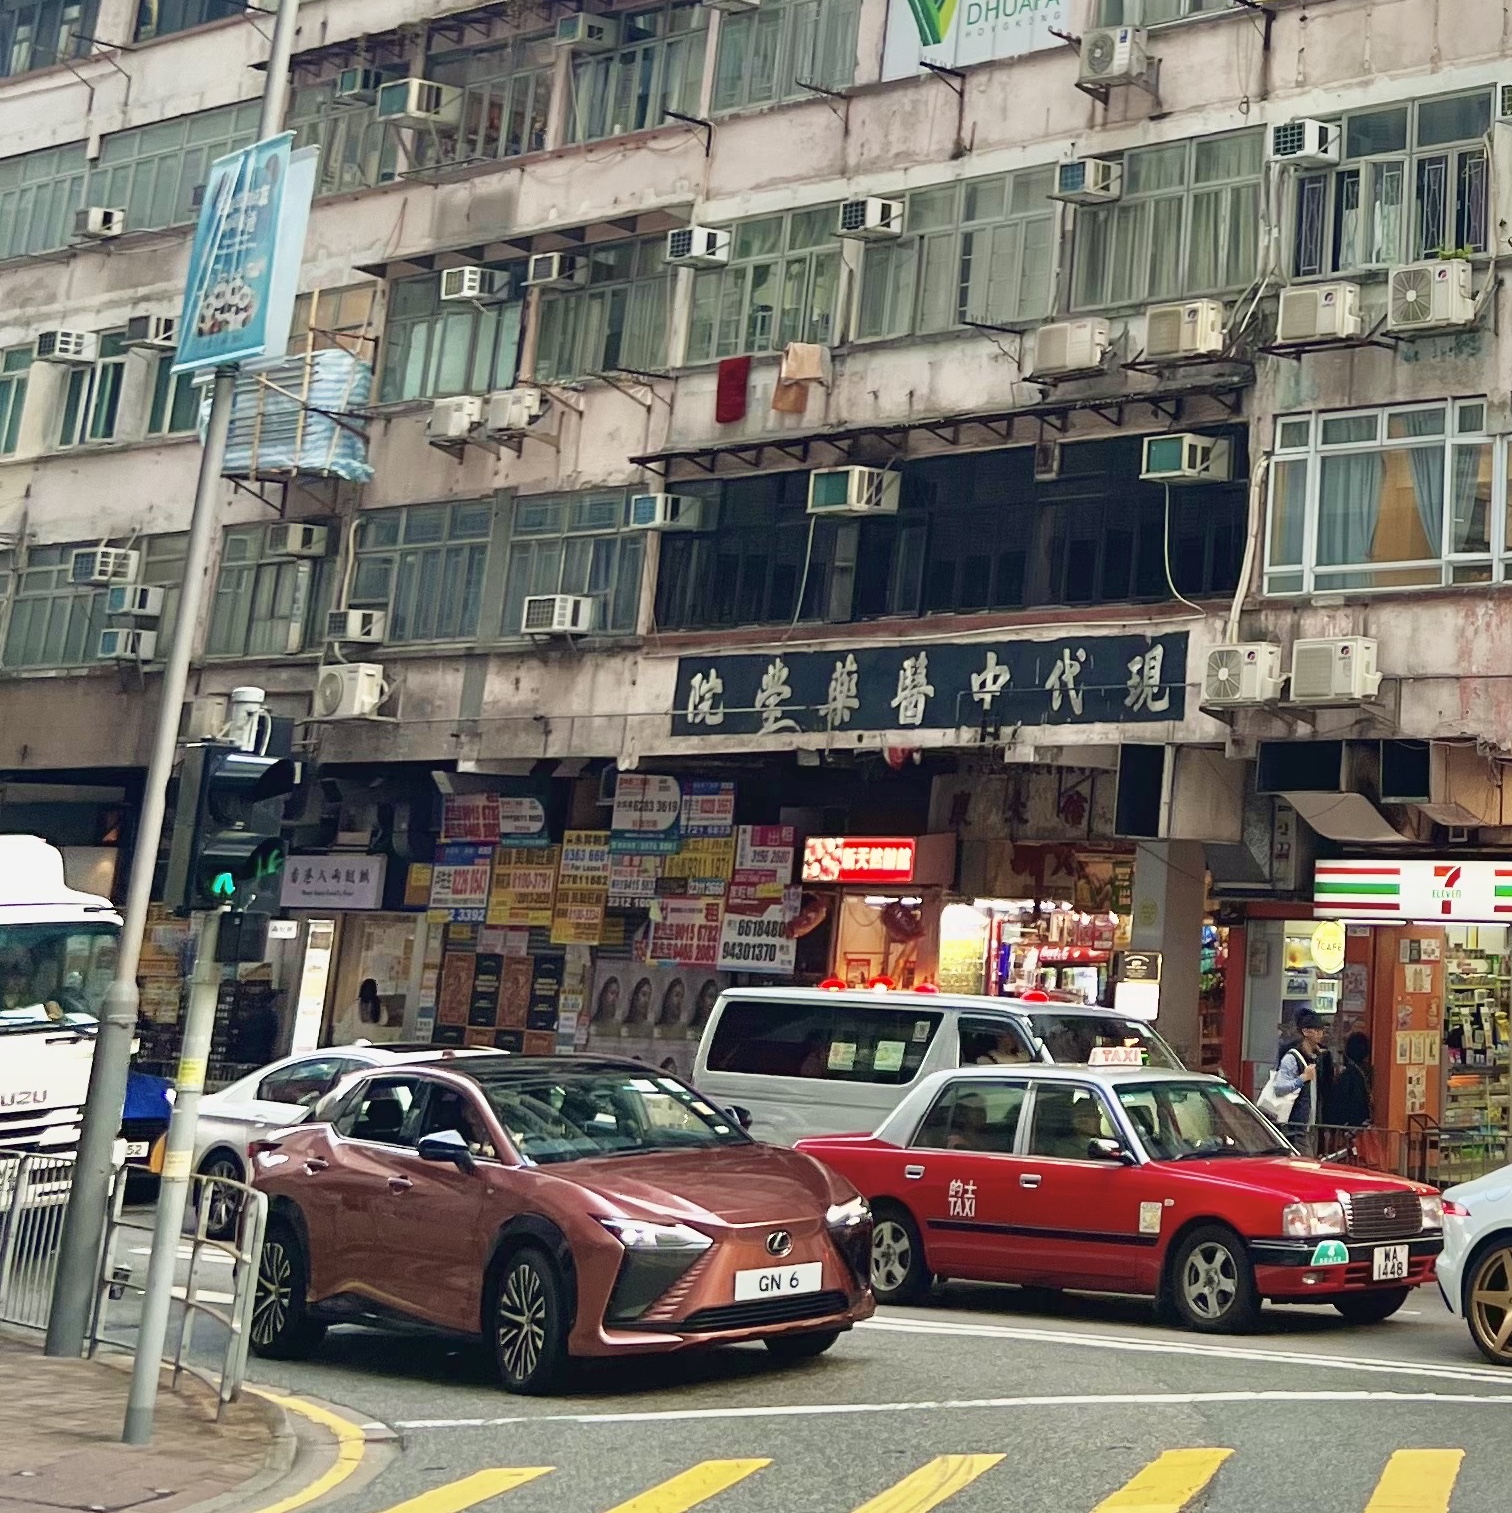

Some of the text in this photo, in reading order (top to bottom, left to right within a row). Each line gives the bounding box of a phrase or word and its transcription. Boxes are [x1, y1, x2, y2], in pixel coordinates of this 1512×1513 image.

[1434, 865, 1462, 914] 7
[1103, 1049, 1139, 1062] TAXI
[949, 1179, 978, 1198] 的士
[948, 1197, 976, 1217] TAXI
[1377, 1261, 1404, 1279] 1448
[758, 1271, 800, 1292] GN 6
